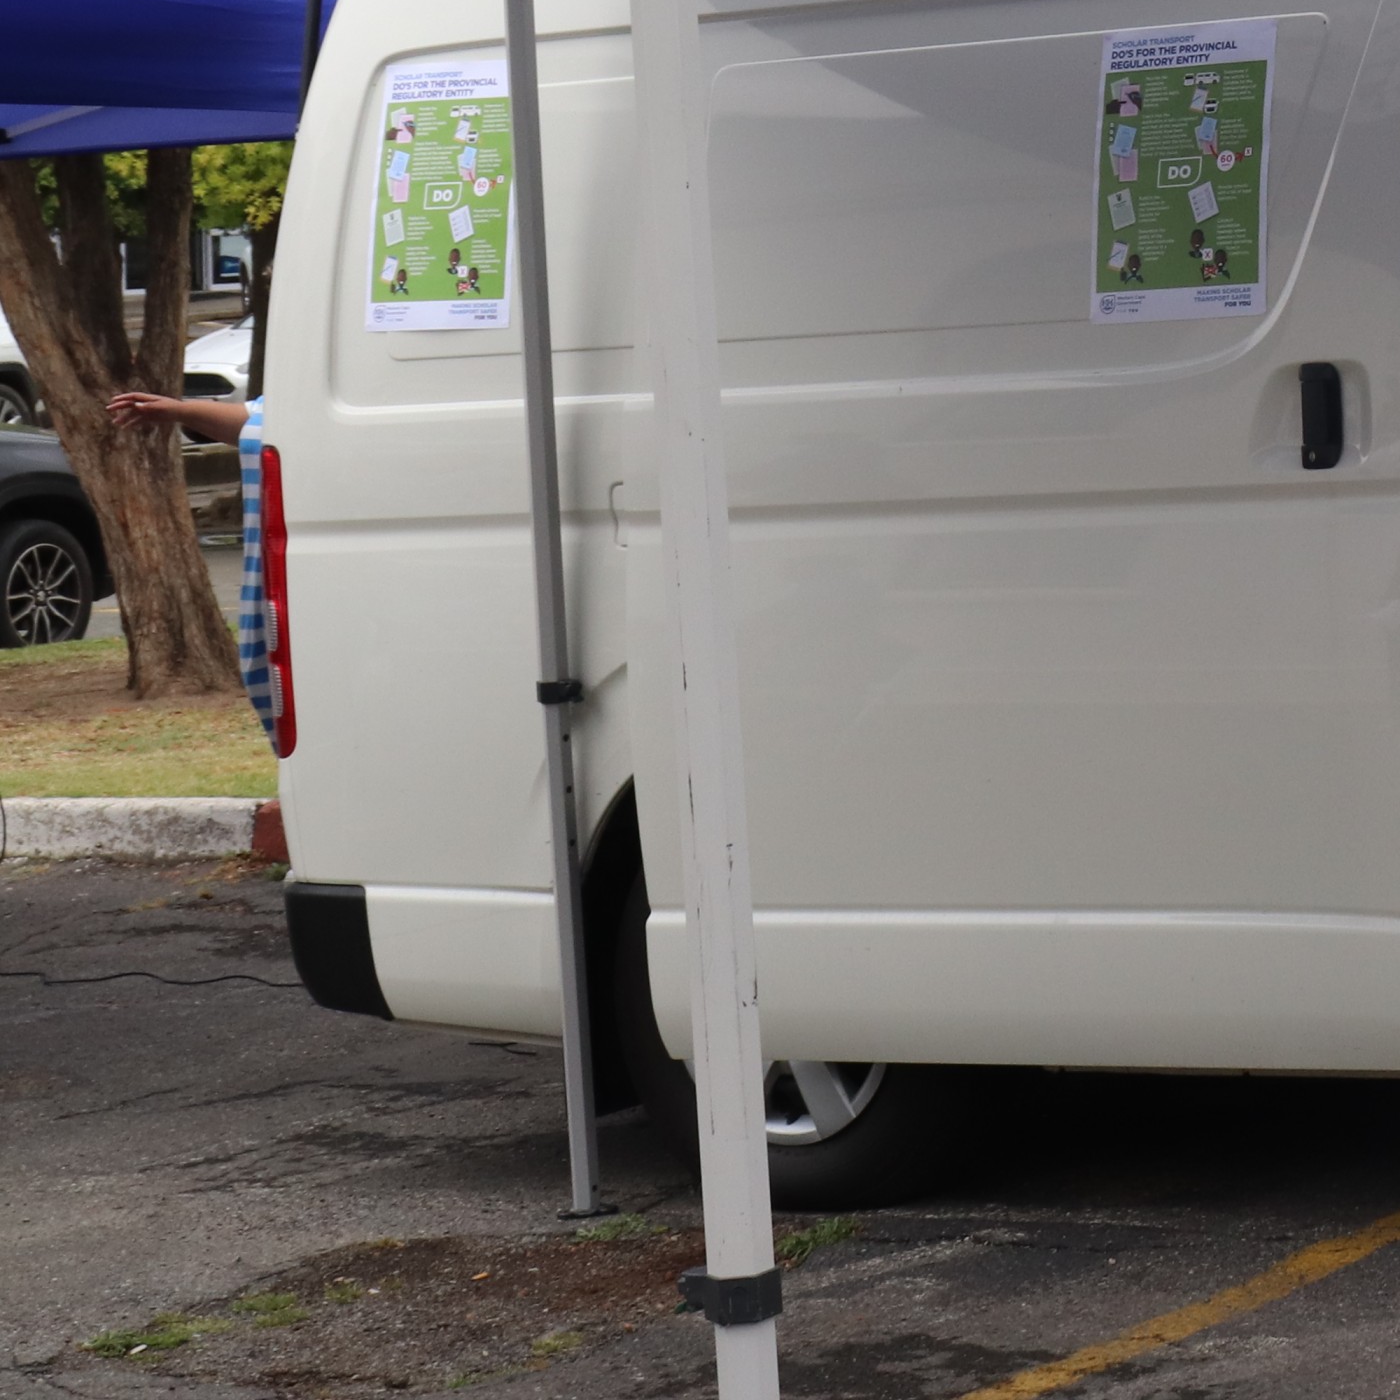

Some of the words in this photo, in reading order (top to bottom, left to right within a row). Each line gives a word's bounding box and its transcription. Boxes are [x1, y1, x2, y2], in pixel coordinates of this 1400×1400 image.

[1112, 38, 1148, 49] SCHOLAR
[1150, 35, 1195, 45] TRANSPORT
[1111, 49, 1134, 60] DO'S
[1136, 47, 1156, 58] FOR
[1158, 45, 1177, 56] THE
[1178, 40, 1238, 54] PROVINCIAL
[1110, 57, 1174, 71] REGULATORY
[1176, 53, 1211, 66] ENTITY
[393, 82, 412, 91] DO'S
[413, 80, 429, 89] FOR
[430, 79, 447, 88] THE
[448, 77, 498, 88] PROVINCIAL
[391, 90, 443, 100] REGULATORY
[445, 88, 474, 98] ENTITY
[1168, 165, 1192, 180] DO
[432, 189, 453, 202] DO
